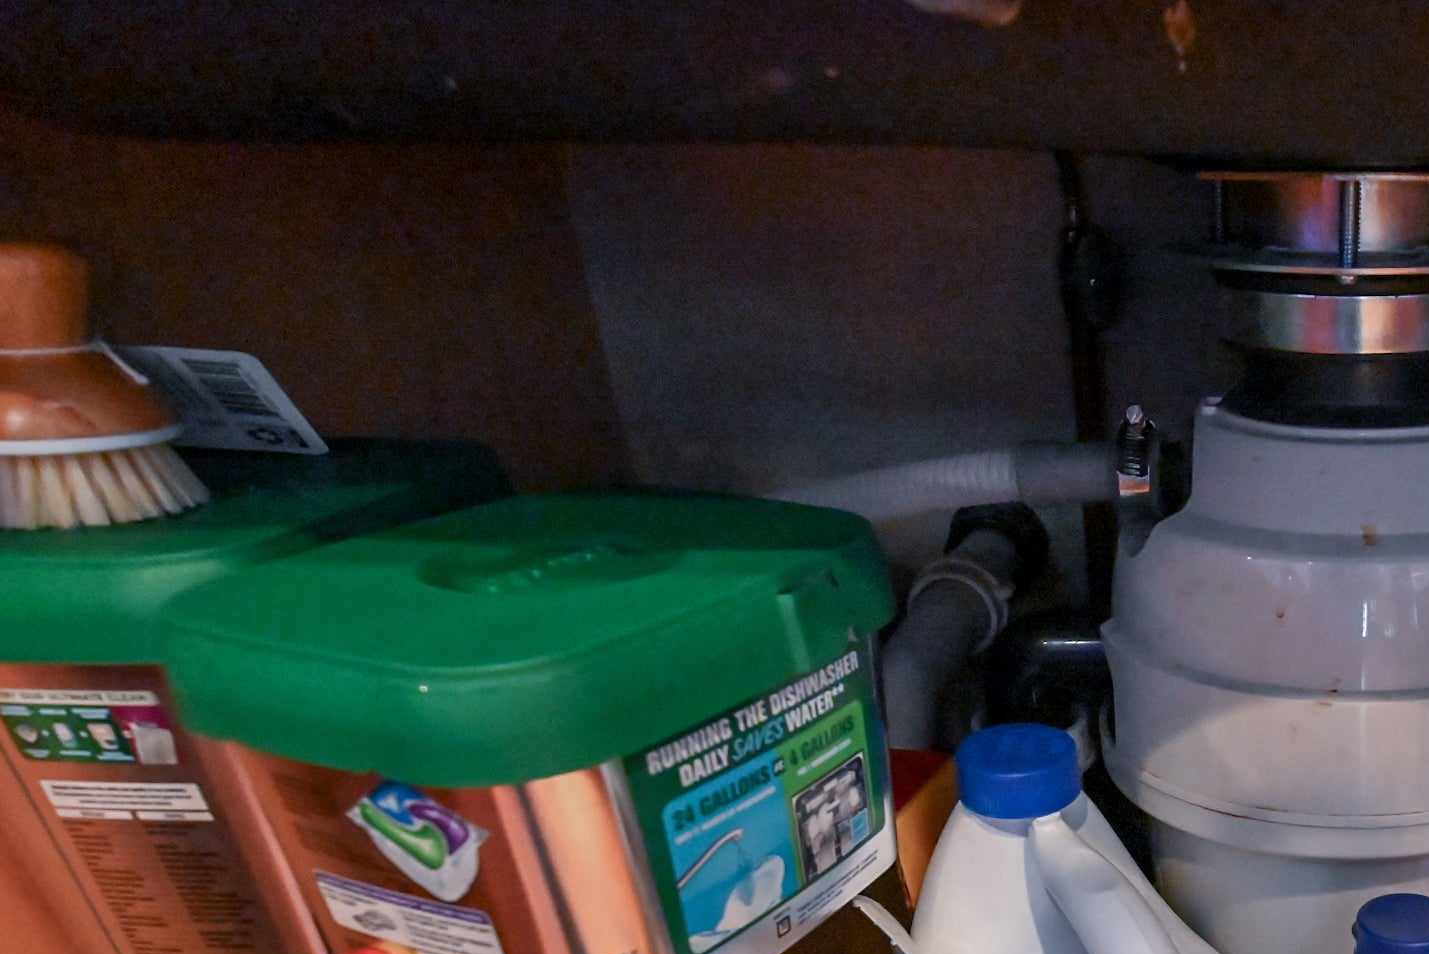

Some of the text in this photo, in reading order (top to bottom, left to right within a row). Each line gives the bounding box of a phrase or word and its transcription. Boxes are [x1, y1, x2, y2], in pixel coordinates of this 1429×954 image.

[646, 717, 733, 775] RUNNING
[734, 700, 767, 731] THE
[769, 651, 859, 716] DISHWASHER
[678, 745, 730, 787] DAILY
[731, 717, 784, 761] SAVES
[671, 808, 695, 831] 24
[699, 765, 771, 817] GALLONS
[802, 714, 855, 760] GALLONS
